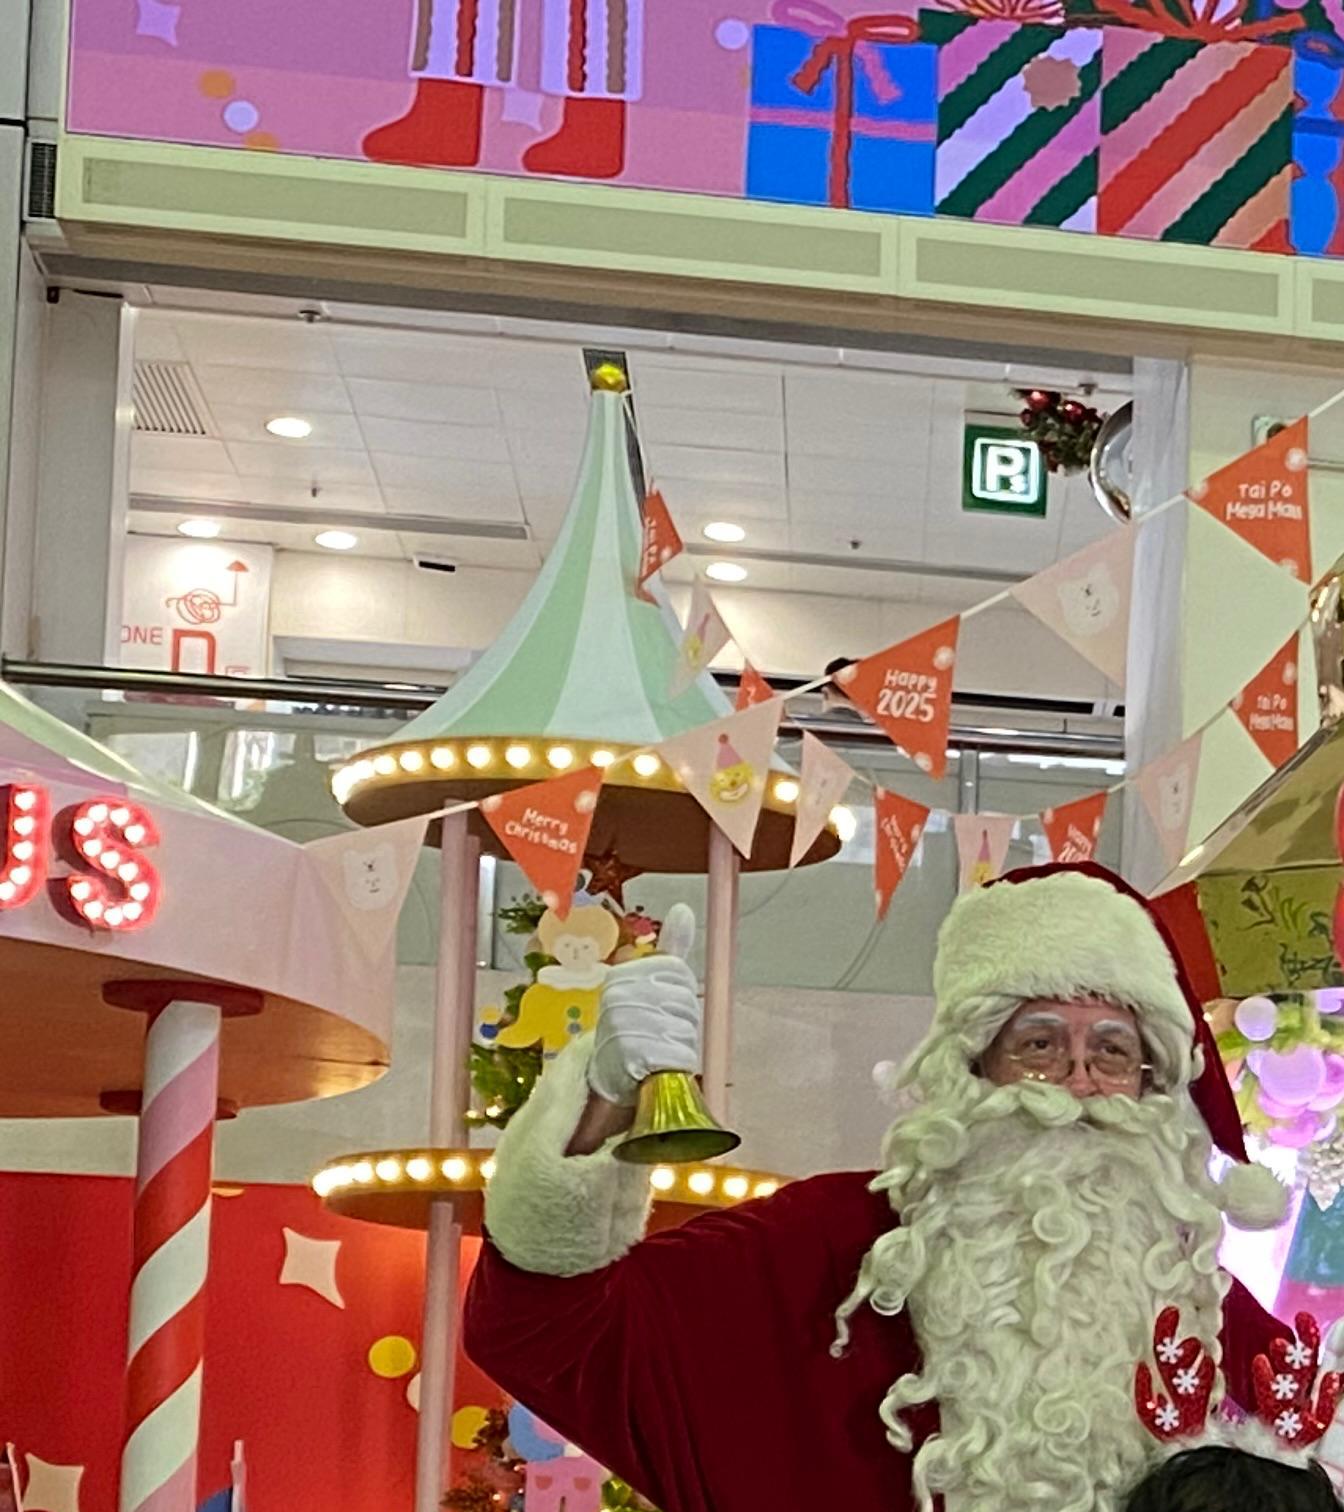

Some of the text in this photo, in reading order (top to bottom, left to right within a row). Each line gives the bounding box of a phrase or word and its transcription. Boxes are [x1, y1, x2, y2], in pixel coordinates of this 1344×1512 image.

[1239, 481, 1293, 498] Tai Po
[884, 668, 938, 699] Happy
[876, 689, 935, 723] 2025
[522, 807, 569, 836] Merry
[504, 821, 578, 856] Christmas
